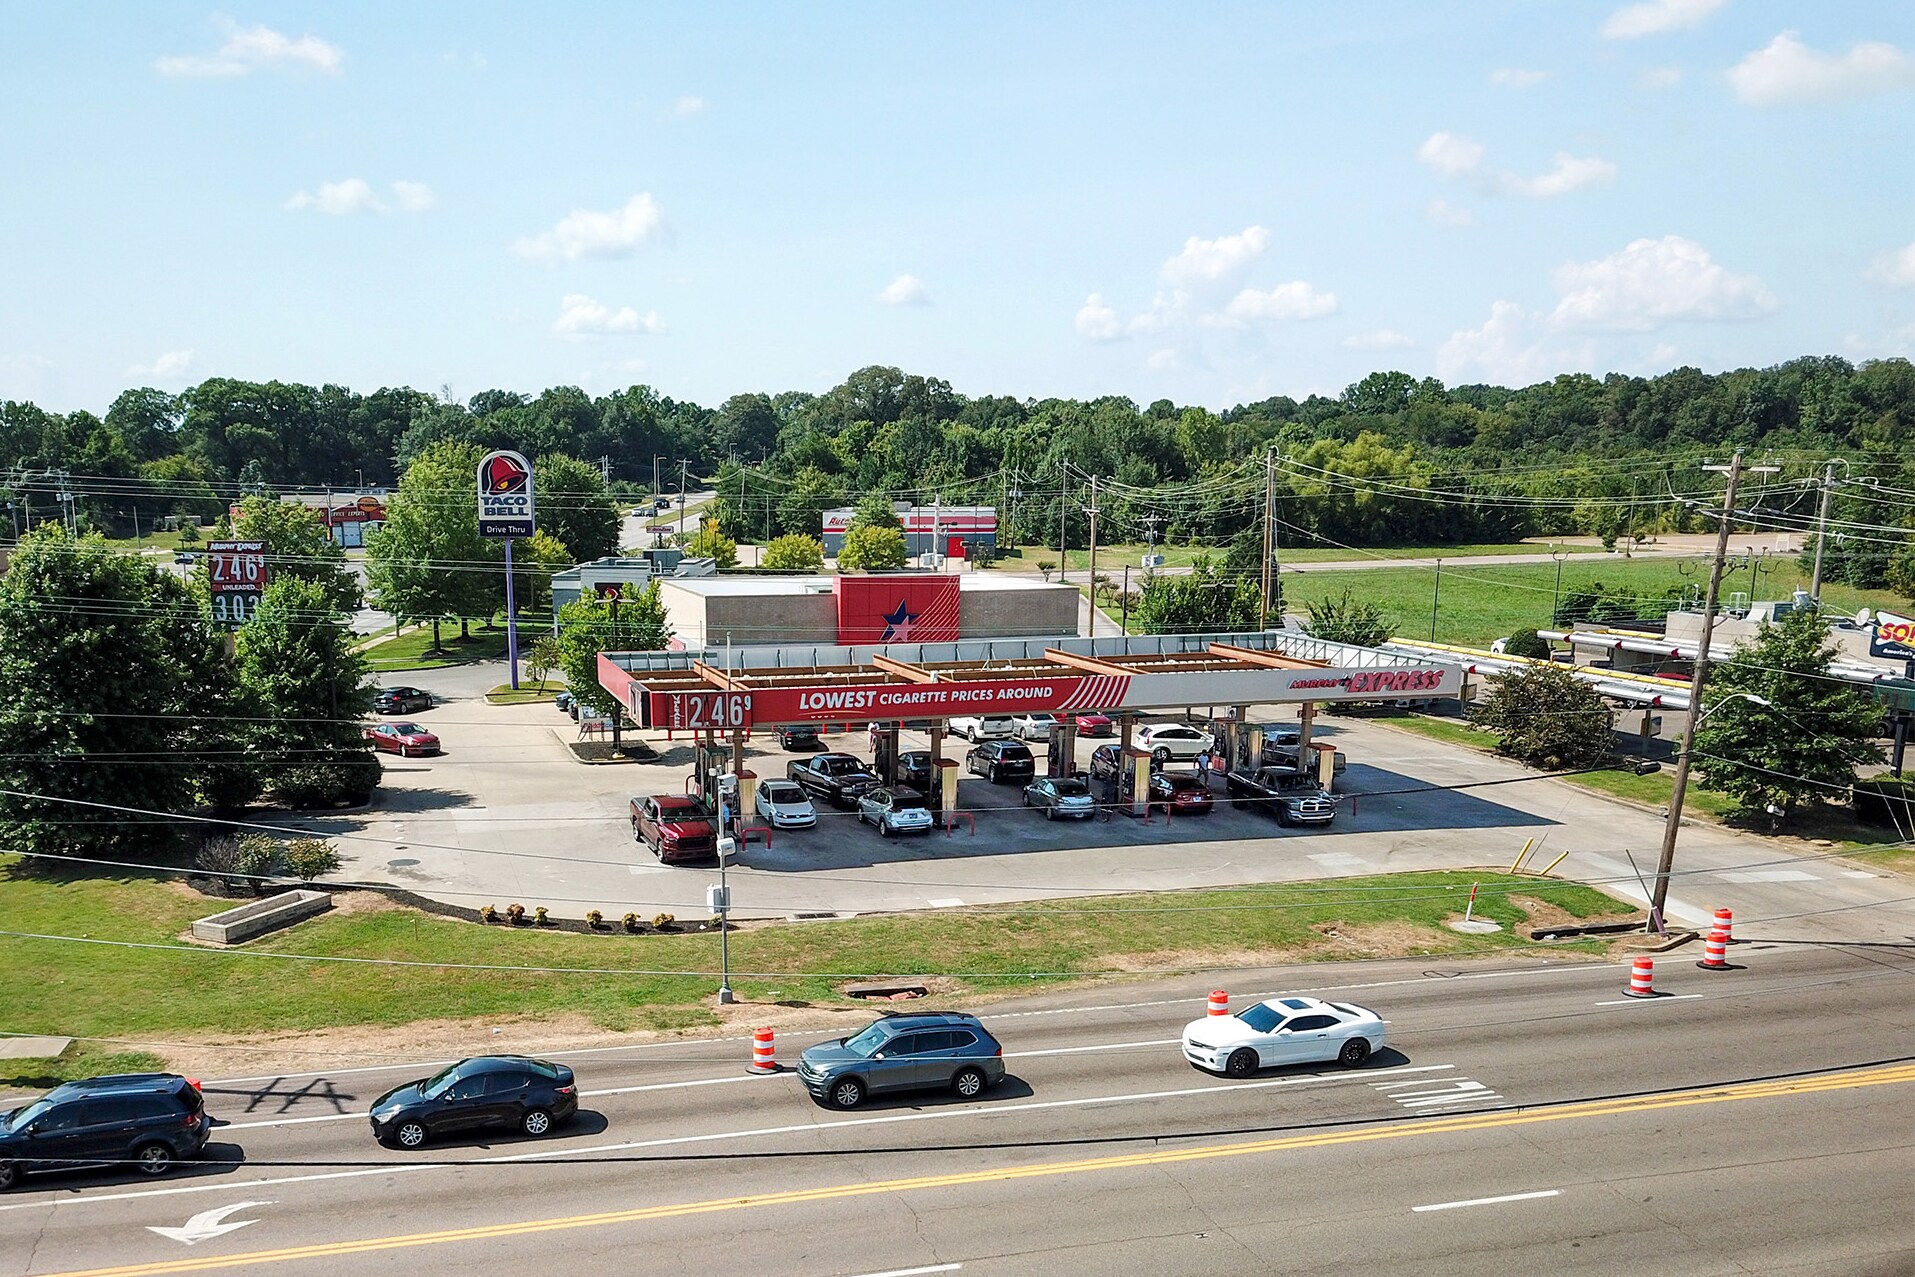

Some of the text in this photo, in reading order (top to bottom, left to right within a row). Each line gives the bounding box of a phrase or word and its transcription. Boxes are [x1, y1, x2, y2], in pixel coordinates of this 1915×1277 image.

[480, 497, 528, 505] TACO
[484, 507, 529, 516] BELL
[486, 525, 506, 533] Drive
[1882, 648, 1913, 656] America's
[1288, 670, 1444, 693] MURPHY EXPRESS
[799, 686, 1053, 710] LOWEST CIGARETTE PRICES AROUND
